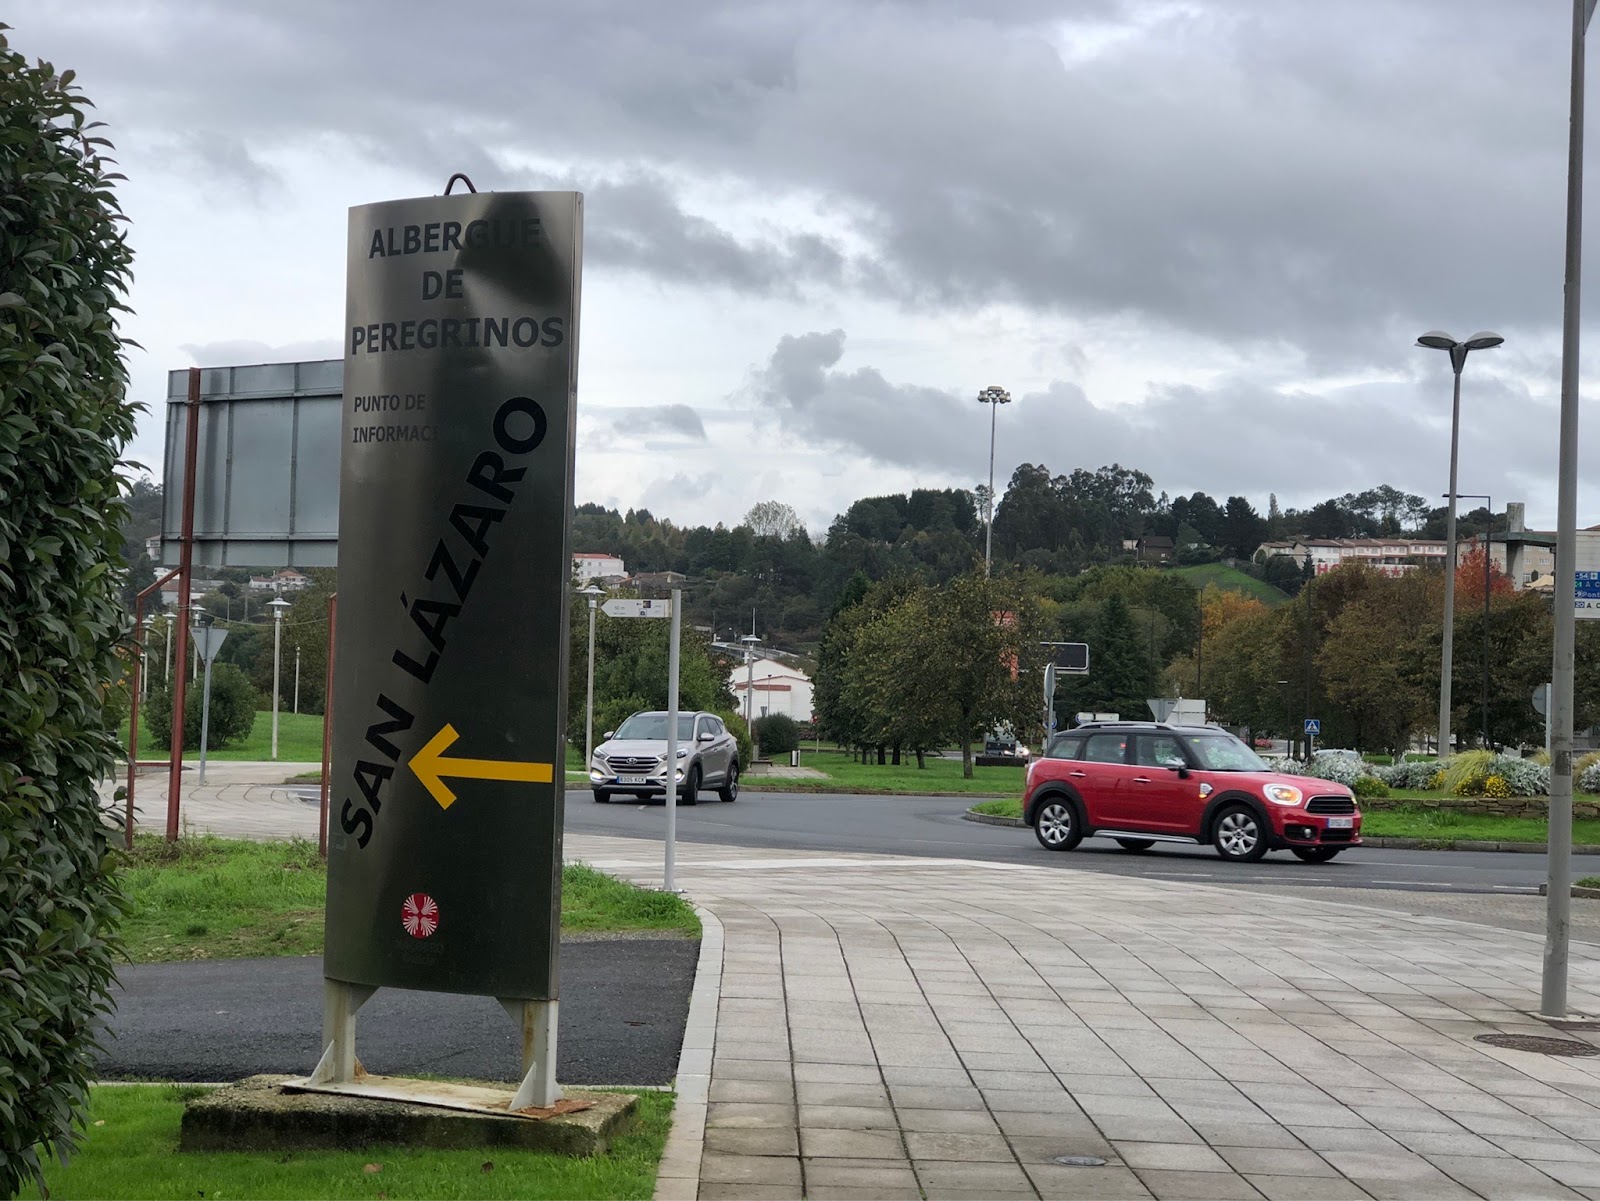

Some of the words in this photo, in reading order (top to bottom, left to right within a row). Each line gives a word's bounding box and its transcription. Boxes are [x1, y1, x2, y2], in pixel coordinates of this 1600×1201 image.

[368, 218, 541, 259] ALBERGUE
[422, 269, 464, 300] DE
[351, 317, 564, 355] PEREGRINOS
[354, 394, 400, 412] PUNTO
[405, 394, 426, 411] DE
[340, 693, 415, 850] SAN
[391, 396, 548, 685] LÁZARO
